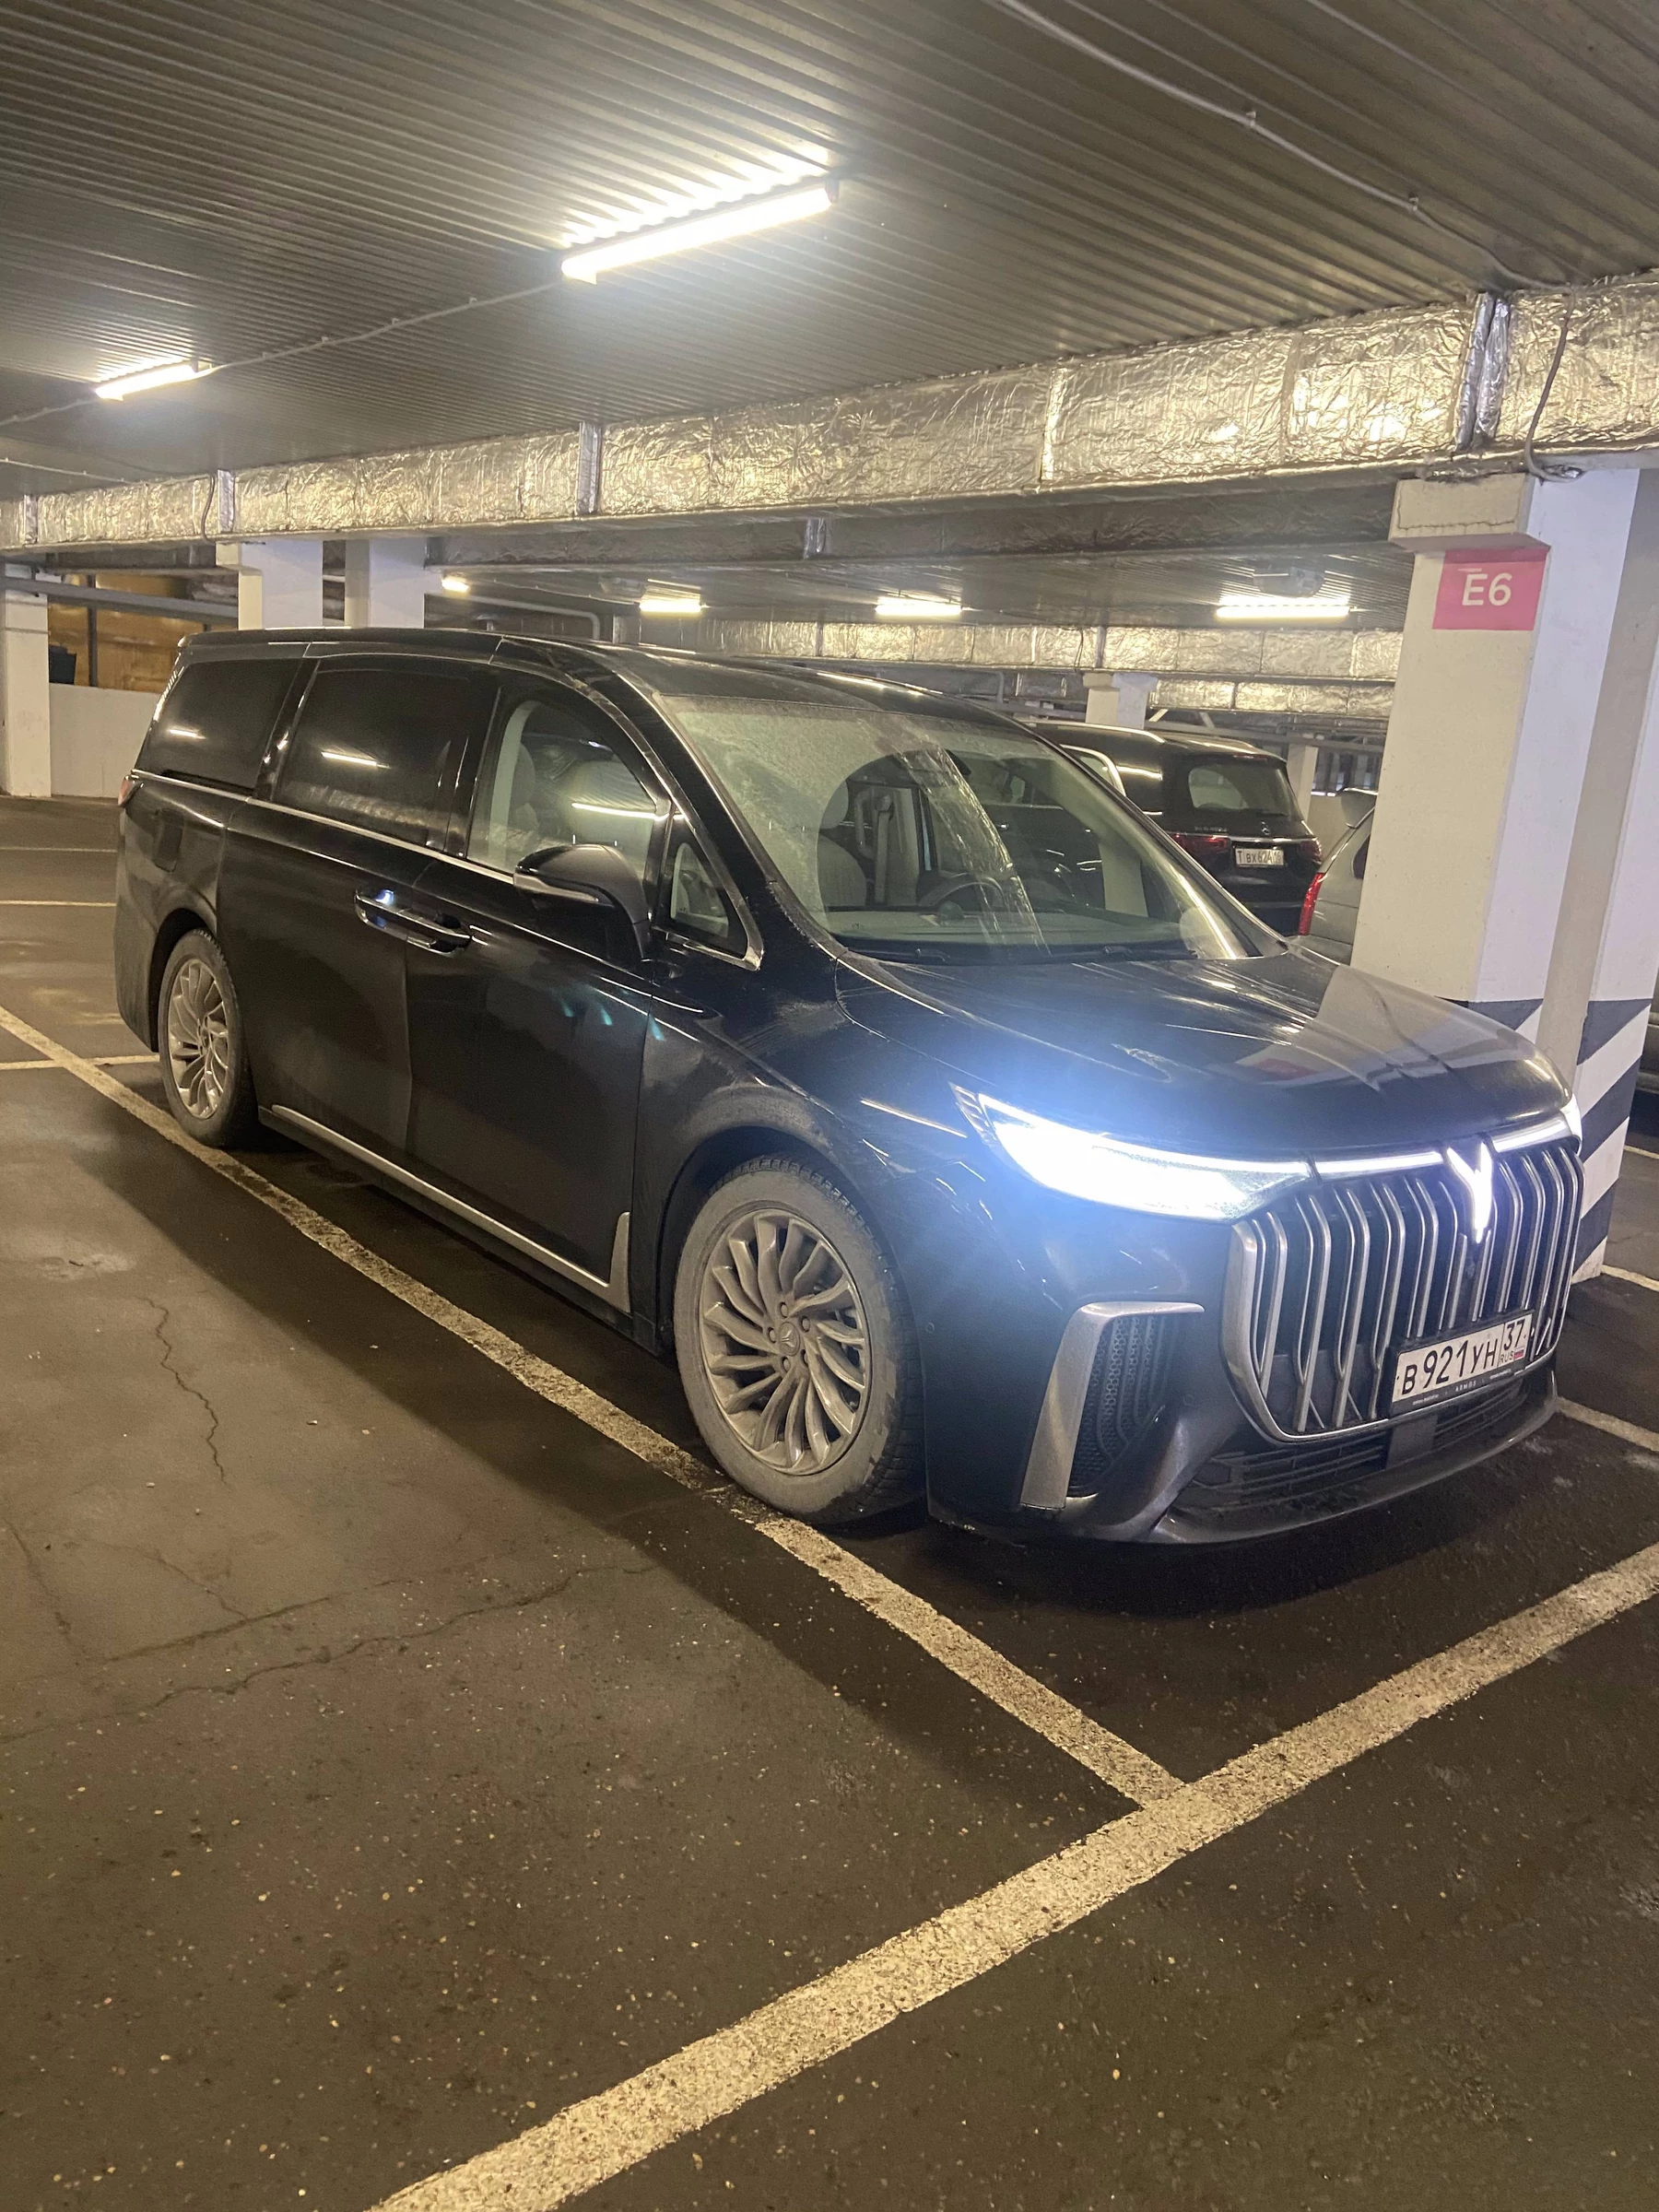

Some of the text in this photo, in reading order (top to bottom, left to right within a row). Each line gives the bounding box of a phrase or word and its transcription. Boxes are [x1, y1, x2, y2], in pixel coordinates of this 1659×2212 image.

[1462, 572, 1512, 606] E6
[1503, 1319, 1526, 1351] 37
[1500, 1350, 1514, 1364] RUS
